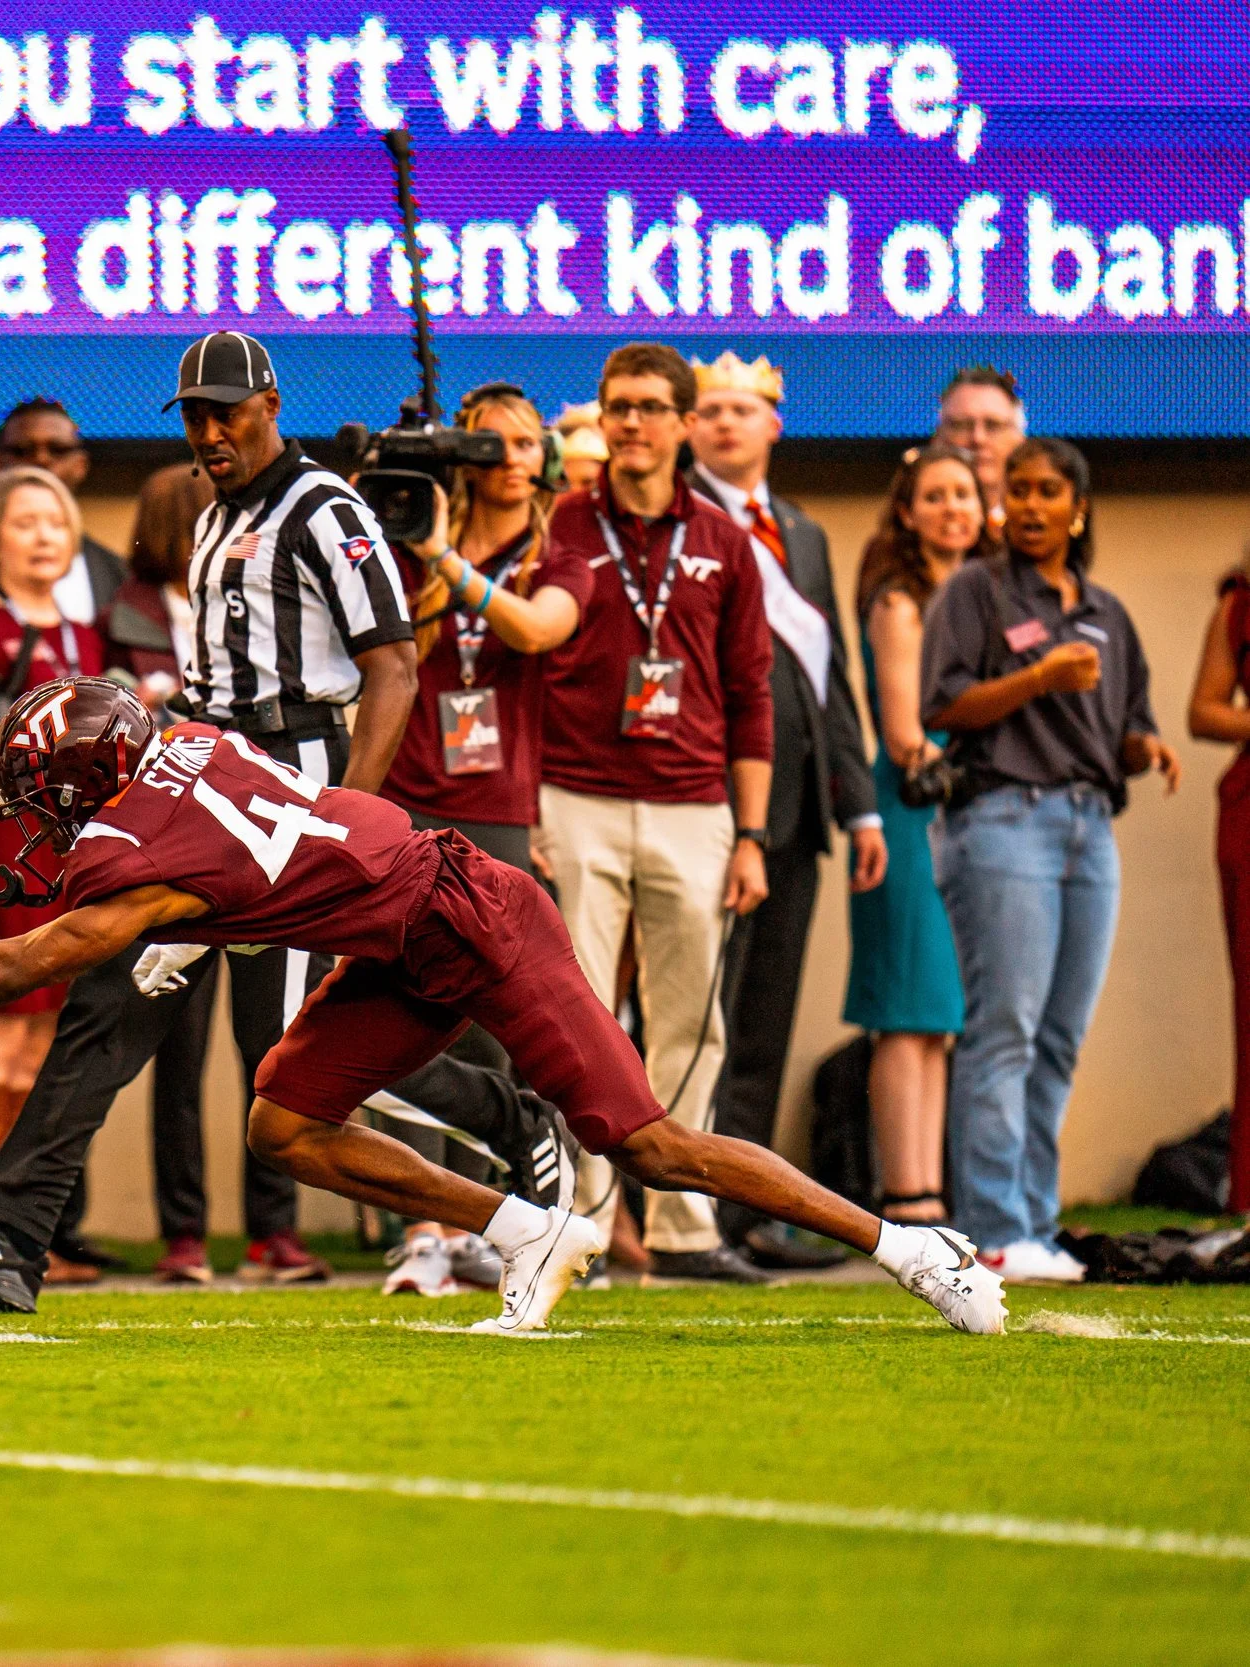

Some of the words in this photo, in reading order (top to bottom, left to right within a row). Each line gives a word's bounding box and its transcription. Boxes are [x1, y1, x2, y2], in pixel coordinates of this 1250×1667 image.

[122, 15, 404, 134] start
[427, 6, 685, 133] with
[710, 40, 984, 162] care,
[76, 190, 581, 318] different
[606, 194, 850, 321] kind
[880, 194, 1002, 321] of
[1026, 197, 1250, 321] ban
[262, 369, 272, 384] S
[677, 553, 723, 583] VT
[225, 589, 246, 619] S
[8, 685, 78, 753] VT
[142, 735, 217, 798] STRNG
